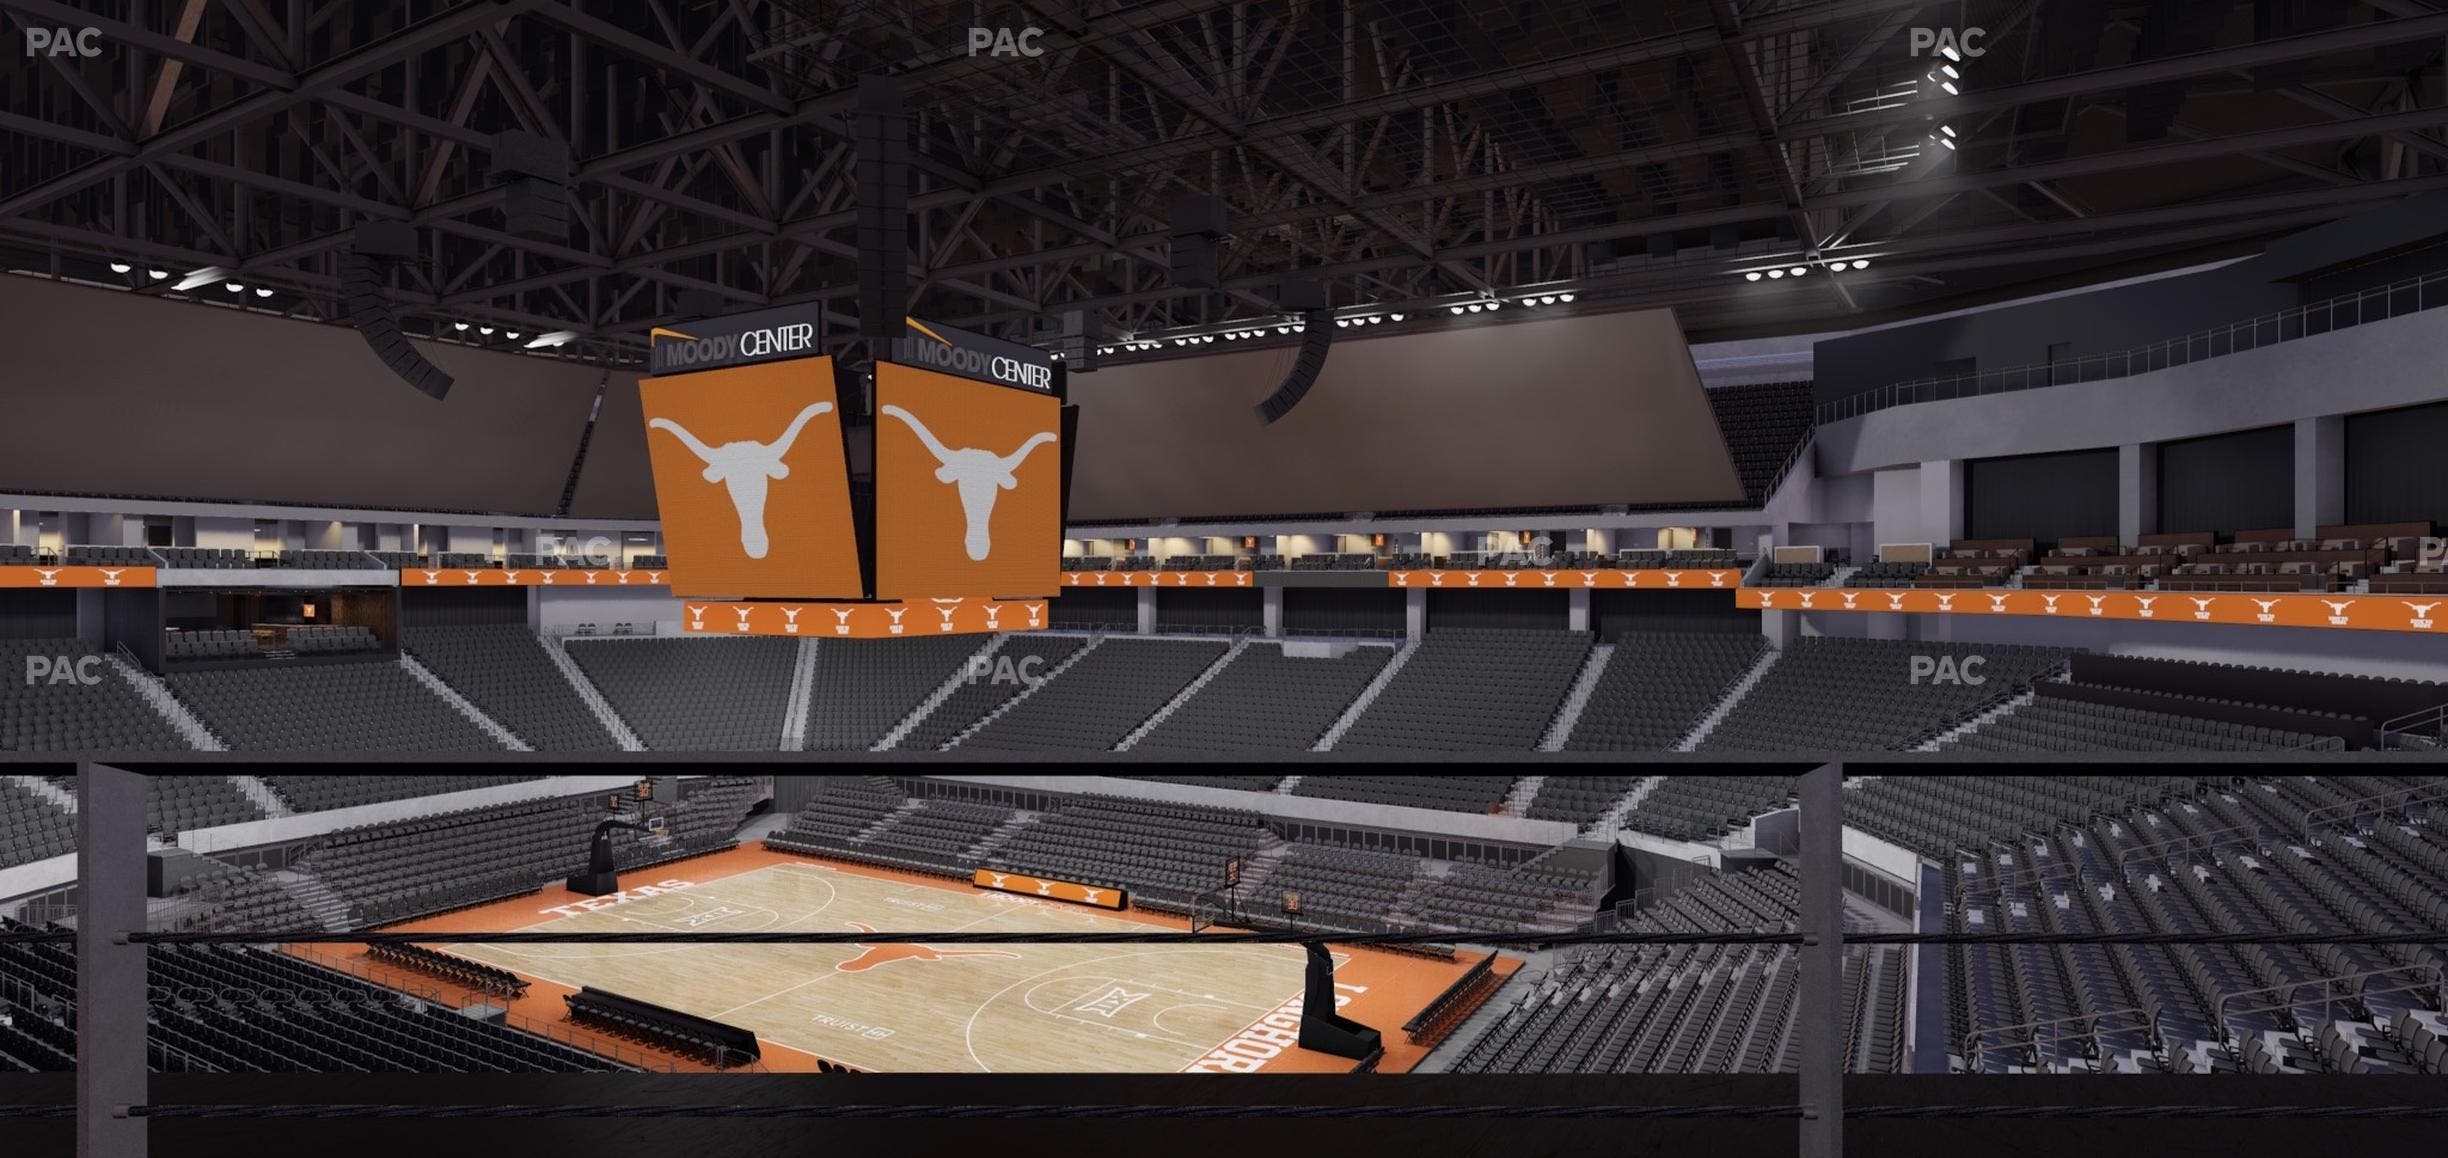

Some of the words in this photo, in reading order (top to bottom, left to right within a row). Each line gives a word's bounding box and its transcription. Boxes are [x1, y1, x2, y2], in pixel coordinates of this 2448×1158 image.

[667, 334, 739, 366] MOODY
[740, 323, 813, 356] CENTER
[918, 338, 992, 375] MOODY
[992, 356, 1051, 389] CENTER
[539, 879, 695, 919] TEXAS
[810, 1014, 869, 1032] TRUIST
